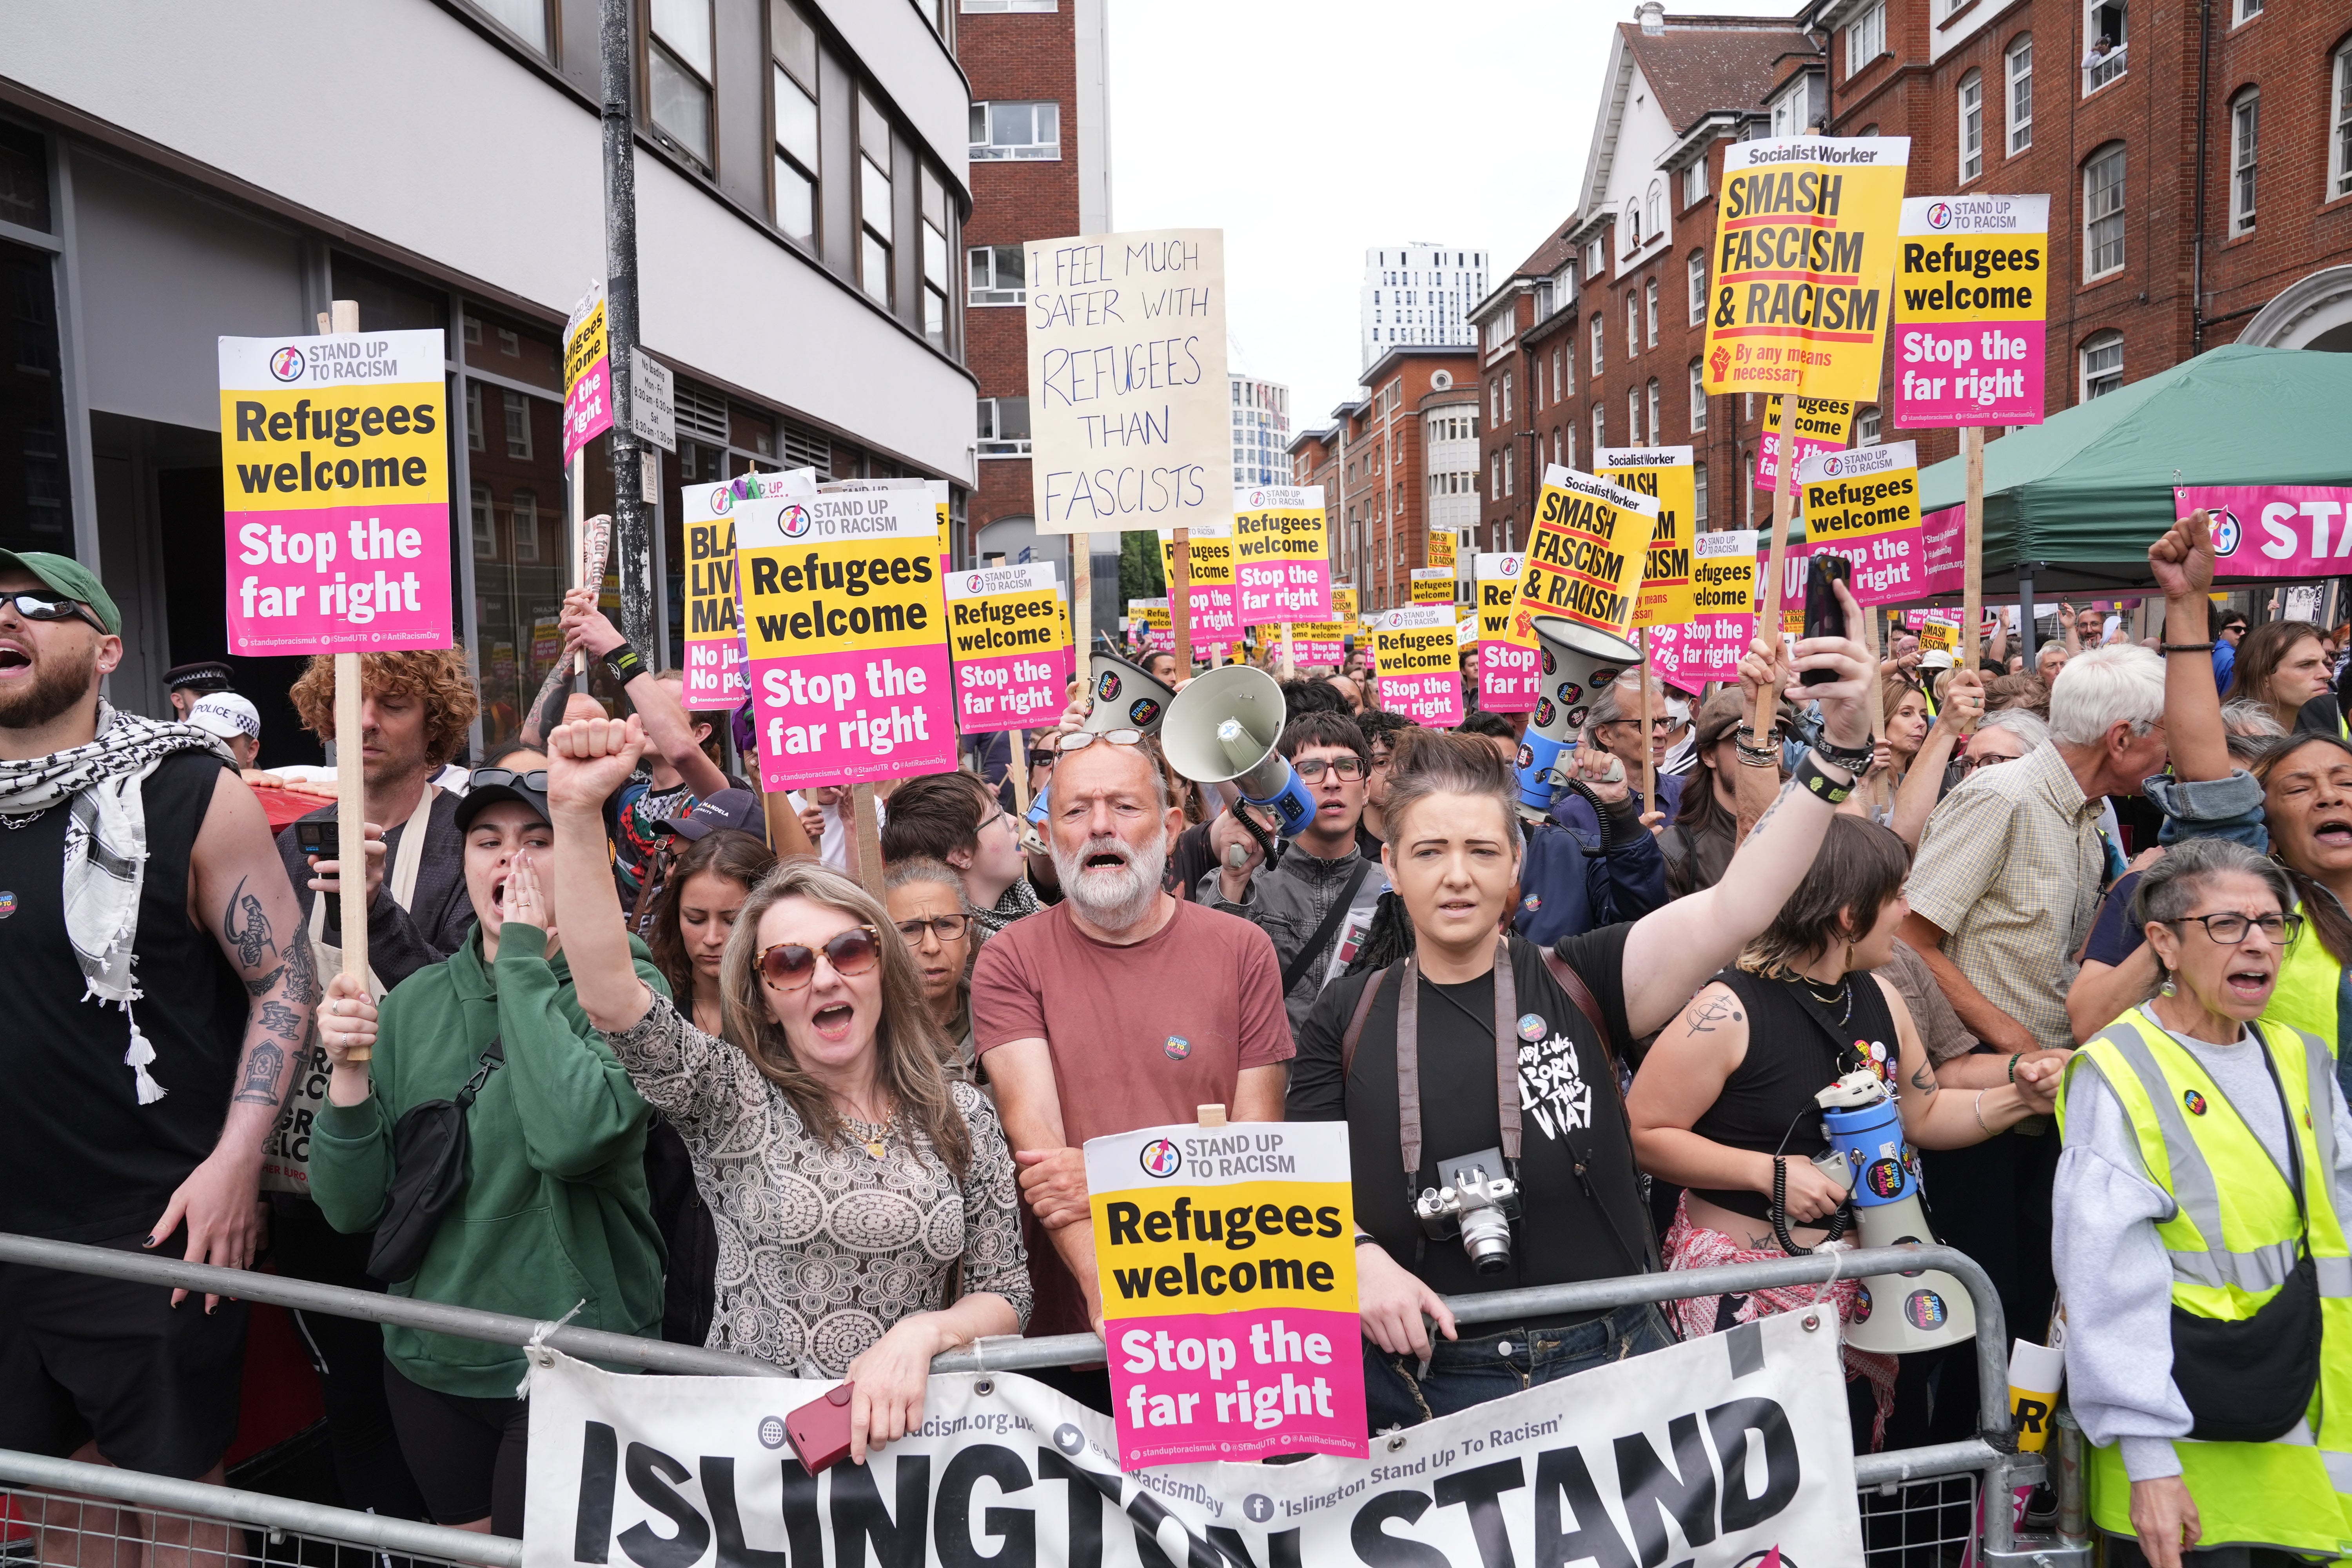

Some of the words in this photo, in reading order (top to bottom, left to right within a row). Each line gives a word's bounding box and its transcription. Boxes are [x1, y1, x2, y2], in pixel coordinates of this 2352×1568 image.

[1727, 172, 1842, 218] SMASH
[1955, 202, 1992, 214] STAND
[1996, 202, 2010, 214] UP
[1955, 217, 1970, 229] TO
[1975, 216, 2016, 228] RACISM
[1721, 227, 1864, 273] FASCISM
[1905, 243, 2039, 278] Refugees
[1033, 252, 1040, 287] I
[1056, 245, 1113, 287] FEEL
[1125, 240, 1199, 277] MUCH
[1715, 287, 1735, 327] &
[1746, 283, 1879, 330] RACISM
[1904, 280, 2032, 310] welcome
[1034, 289, 1125, 329] SAFER
[1142, 287, 1209, 320] WITH
[310, 343, 360, 362] STAND
[367, 342, 388, 358] UP
[1736, 344, 1752, 364] By
[1757, 347, 1782, 365] any
[1787, 347, 1833, 367] means
[1903, 332, 1972, 368] Stop
[1981, 330, 2026, 360] the
[309, 361, 331, 381] TO
[334, 360, 397, 378] RACISM
[642, 358, 648, 370] No
[650, 363, 664, 382] loading
[1044, 336, 1201, 410] REFUGEES
[1733, 368, 1804, 387] necessary
[579, 374, 600, 402] the
[645, 377, 654, 390] Mon
[1903, 370, 1946, 400] far
[1956, 368, 2024, 407] right
[634, 386, 645, 400] 8.30
[646, 396, 653, 405] am
[656, 398, 666, 412] 6.30
[667, 406, 673, 416] pm
[236, 399, 435, 447] Refugees
[1077, 404, 1169, 449] THAN
[1908, 413, 1953, 421] standuptoracismuk
[636, 419, 646, 433] 8.30
[648, 428, 654, 437] am
[657, 430, 666, 443] 1.30
[667, 437, 673, 446] pm
[236, 451, 426, 493] welcome
[769, 481, 783, 494] UP
[1047, 463, 1205, 522] FASCISTS
[1809, 479, 1913, 508] Refugees
[814, 501, 863, 518] STAND
[868, 500, 888, 514] UP
[1543, 492, 1617, 540] SMASH
[1811, 506, 1909, 533] welcome
[596, 518, 610, 537] Art
[815, 520, 835, 535] TO
[841, 517, 897, 533] RACISM
[1238, 514, 1321, 534] Refugees
[240, 523, 336, 573] Stop
[348, 518, 421, 560] the
[595, 540, 607, 557] for
[1239, 536, 1318, 555] welcome
[1430, 532, 1446, 542] SMASH
[1430, 544, 1451, 554] FASCISM
[1873, 538, 1909, 560] the
[1434, 556, 1454, 565] RACISM
[1533, 530, 1624, 583] FASCISM
[751, 553, 932, 596] Refugees
[985, 571, 1011, 581] STAND
[1014, 570, 1025, 578] UP
[986, 583, 995, 591] TO
[998, 579, 1031, 590] RACISM
[1241, 568, 1284, 588] Stop
[1289, 565, 1318, 583] the
[1414, 581, 1451, 590] Refugees
[1785, 557, 1808, 599] UP
[1857, 563, 1910, 591] right
[240, 576, 305, 617] far
[320, 571, 421, 623] right
[1211, 590, 1231, 606] the
[1242, 591, 1270, 610] far
[1275, 588, 1318, 610] right
[1523, 569, 1541, 599] &
[1548, 575, 1628, 624] RACISM
[1645, 594, 1667, 604] means
[756, 601, 927, 642] welcome
[954, 601, 1053, 625] Refugees
[1203, 610, 1234, 631] right
[250, 637, 317, 646] standuptoracismuk
[381, 631, 439, 640] @AntiRacismDay
[1311, 623, 1342, 631] Refugees
[1683, 622, 1712, 644] Stop
[1715, 619, 1742, 639] the
[1923, 624, 1945, 638] SMASH
[957, 628, 1051, 651] welcome
[1312, 643, 1327, 652] Stop
[1378, 633, 1453, 651] Refugees
[692, 646, 717, 666] No
[1323, 652, 1339, 661] right
[1380, 653, 1451, 669] welcome
[1682, 648, 1702, 663] far
[1704, 644, 1740, 668] right
[691, 669, 717, 689] No
[763, 669, 855, 711] Stop
[866, 659, 926, 697] the
[961, 666, 1008, 690] Stop
[1013, 660, 1051, 682] the
[964, 693, 994, 714] far
[1000, 686, 1053, 714] right
[1382, 681, 1419, 699] Stop
[1423, 677, 1451, 694] the
[195, 704, 231, 719] POLICE
[1412, 697, 1452, 718] right
[767, 717, 826, 755] far
[839, 706, 929, 755] right
[781, 769, 841, 780] standuptoracismuk
[853, 763, 888, 773] @StandUTR
[900, 754, 946, 768] @AntiRacismDay
[1541, 1041, 1552, 1055] I
[1550, 1032, 1569, 1054] WAS
[1518, 1041, 1579, 1110] BORN
[1532, 1085, 1591, 1140] WAY
[1186, 1135, 1249, 1156] STAND
[1256, 1135, 1283, 1152] UP
[1187, 1160, 1212, 1178] TO
[1220, 1155, 1295, 1176] RACISM
[1107, 1197, 1342, 1250] Refugees
[1113, 1253, 1334, 1299] welcome
[1914, 1296, 1927, 1327] RACISM
[1930, 1295, 1942, 1323] STAND
[1122, 1330, 1236, 1380] Stop
[1249, 1320, 1332, 1364] the
[1127, 1385, 1200, 1428] far
[1215, 1374, 1334, 1430] right
[1143, 1443, 1216, 1457] standuptoracismuk
[1231, 1438, 1275, 1451] @StandUTR
[1292, 1435, 1356, 1449] @AntiRacismDay
[1371, 1457, 1425, 1484] Stand
[1432, 1448, 1456, 1471] Up
[1460, 1436, 1485, 1458] To
[574, 1420, 1301, 1568] ISLINGTO
[1350, 1397, 1800, 1568] STAND
